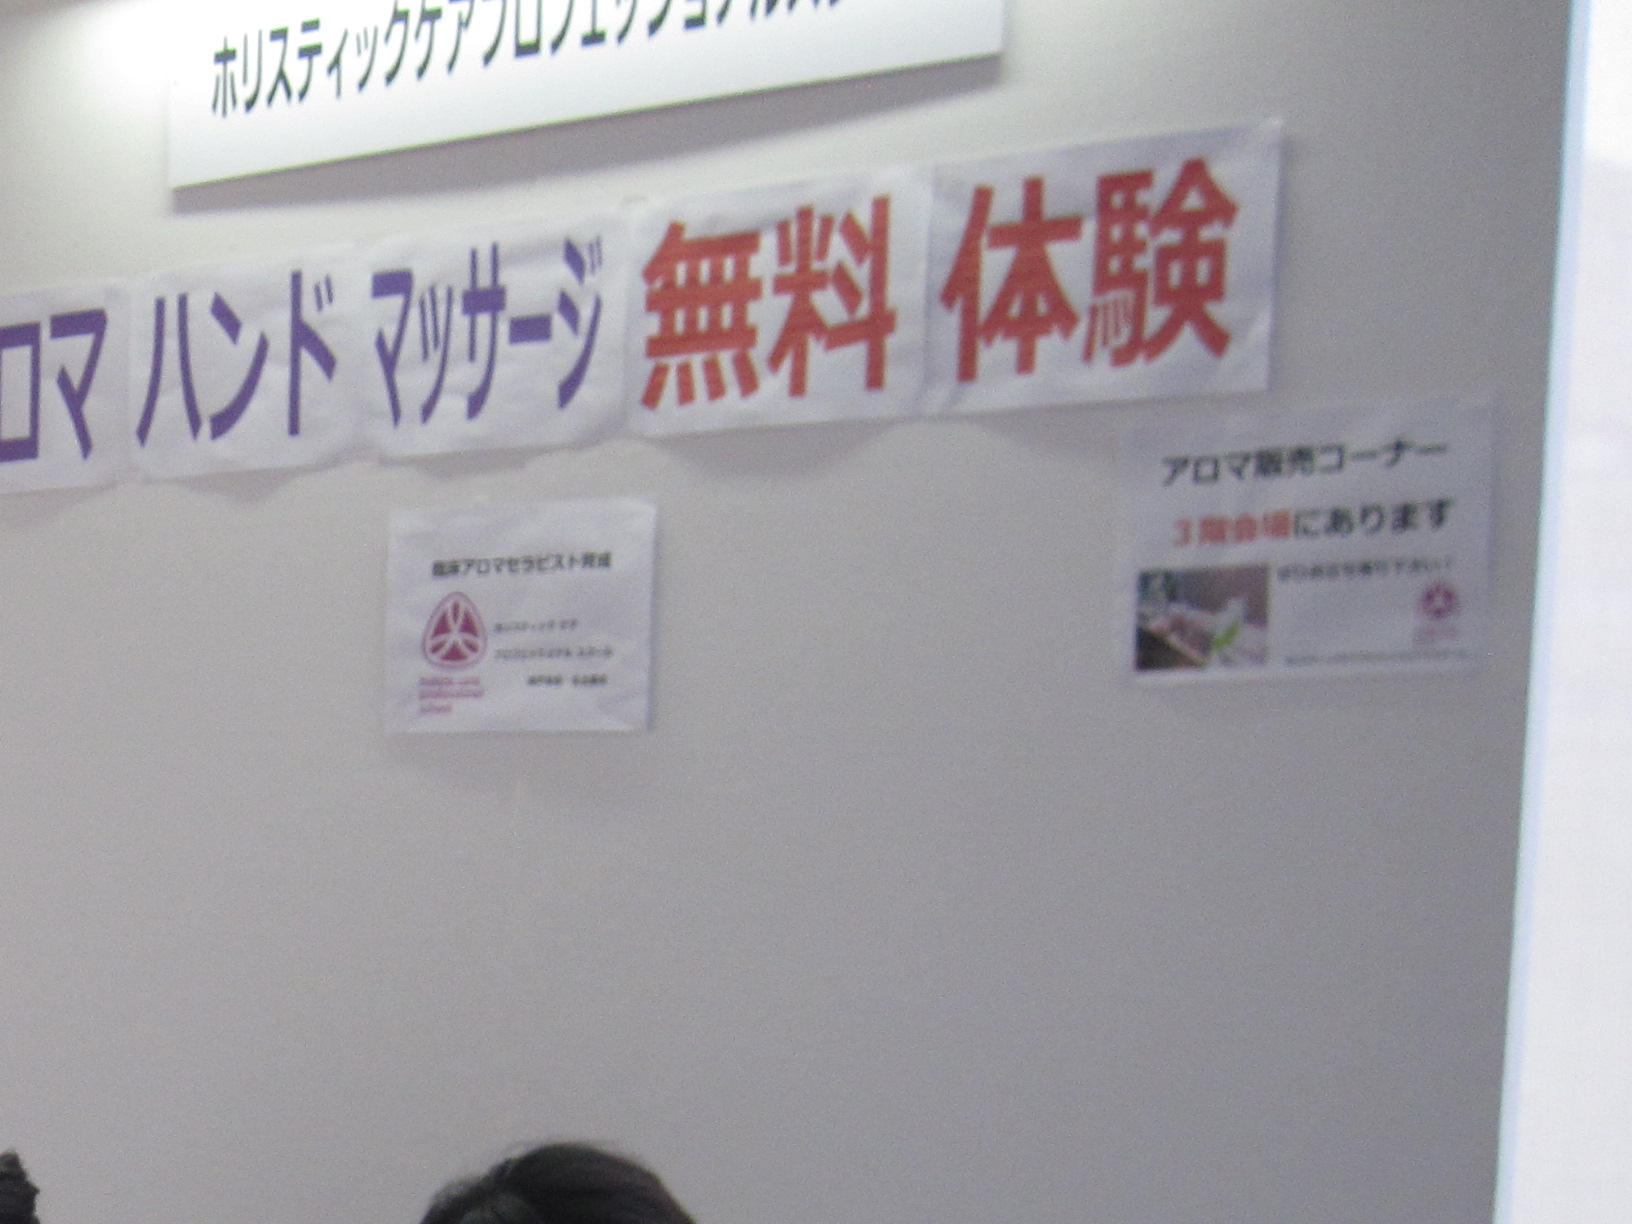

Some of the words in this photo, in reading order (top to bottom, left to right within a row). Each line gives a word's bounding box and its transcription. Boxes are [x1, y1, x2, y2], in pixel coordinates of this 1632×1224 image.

[134, 271, 338, 449] ハンド
[370, 240, 603, 428] マッサージ
[640, 195, 898, 410] 無料
[939, 157, 1239, 384] 体験
